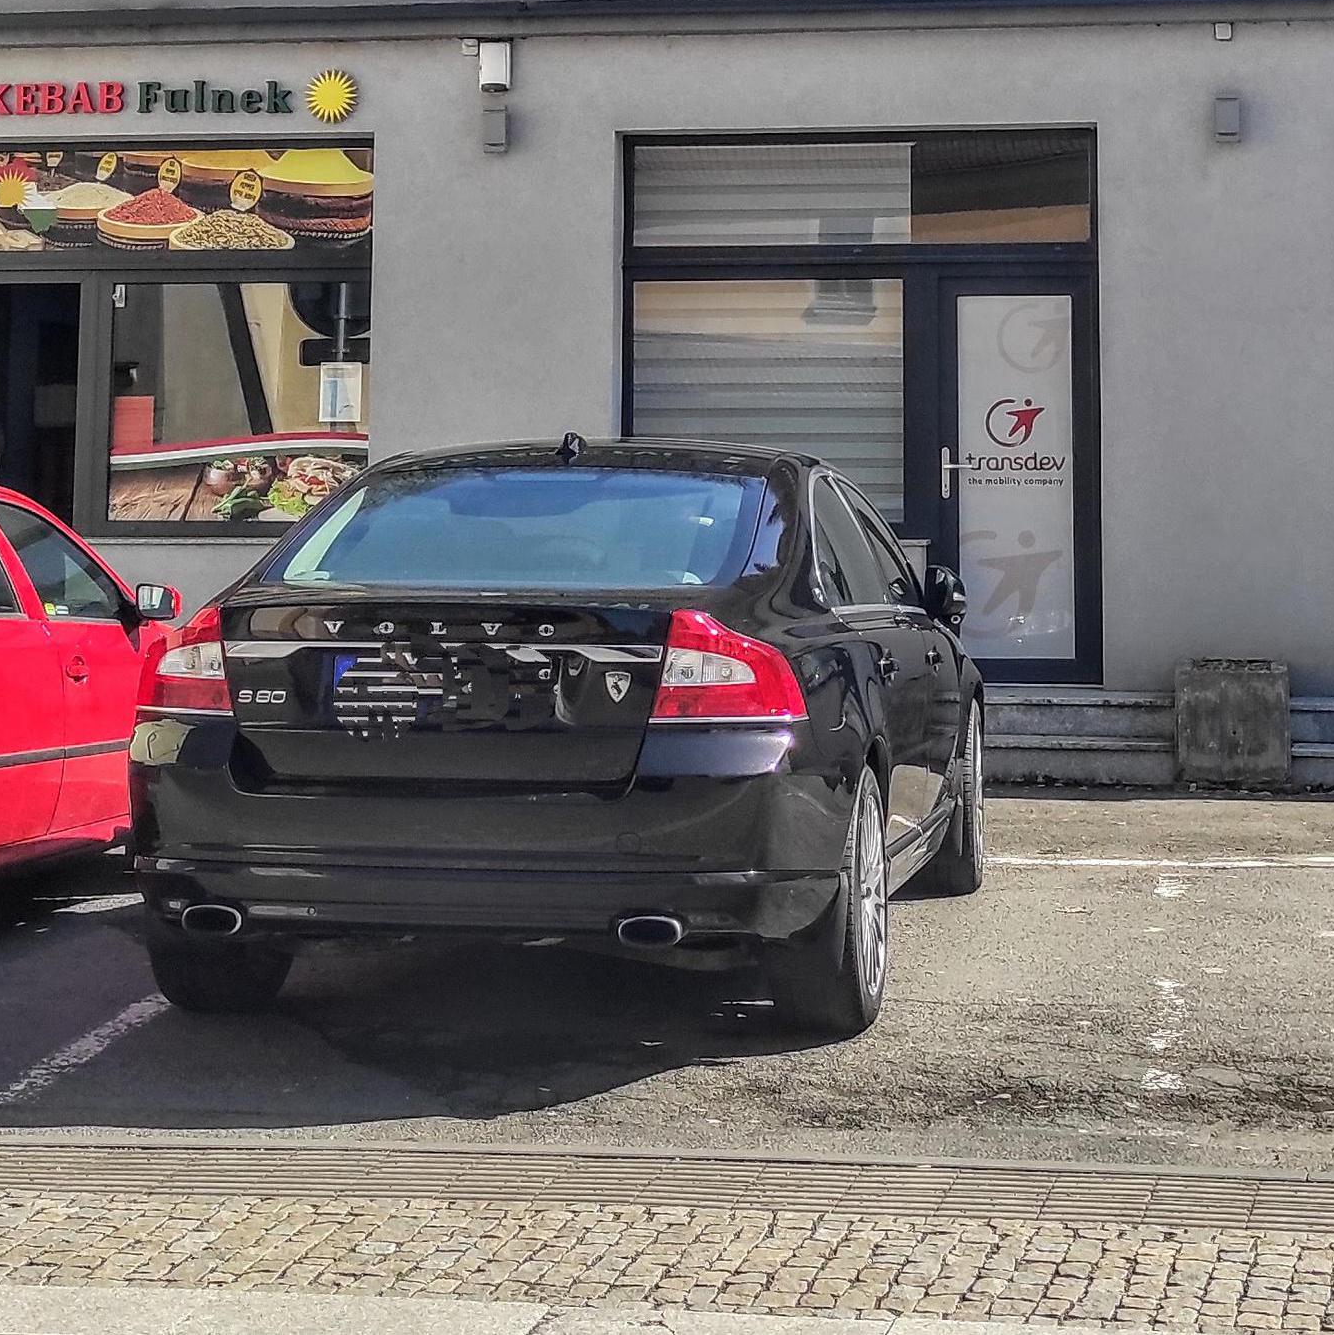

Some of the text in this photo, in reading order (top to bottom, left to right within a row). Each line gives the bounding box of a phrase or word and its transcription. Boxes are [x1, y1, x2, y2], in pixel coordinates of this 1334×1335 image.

[135, 79, 294, 115] Fulnek
[965, 451, 1067, 472] transdev
[968, 476, 1064, 487] the mobility company
[323, 619, 555, 639] VOLVO
[237, 688, 287, 705] S80
